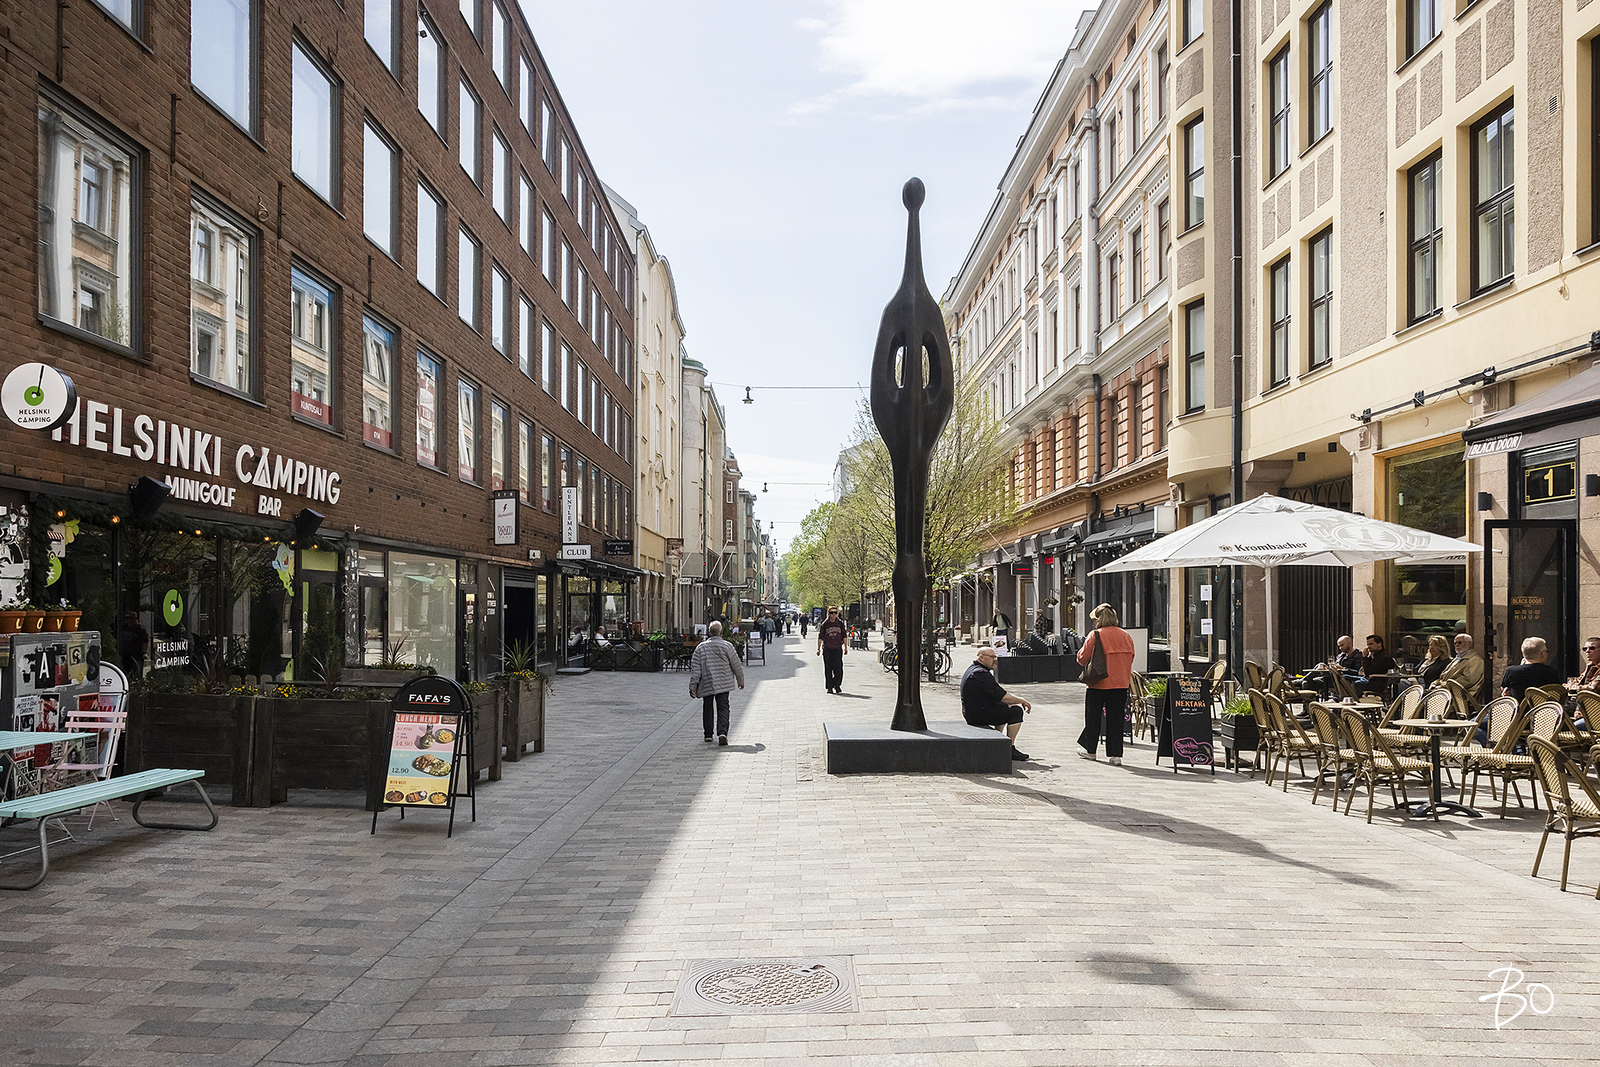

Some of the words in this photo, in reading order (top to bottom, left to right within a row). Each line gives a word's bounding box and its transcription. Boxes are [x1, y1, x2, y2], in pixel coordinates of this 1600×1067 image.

[52, 396, 222, 477] HELSINKI
[235, 443, 341, 505] CAMPING
[1470, 440, 1497, 455] BLACK
[1495, 436, 1519, 451] DOOR
[1543, 468, 1554, 497] 1
[165, 474, 236, 508] MINIGOLF
[257, 495, 282, 517] BAR
[1234, 541, 1308, 552] Krombacher
[156, 641, 189, 652] HELSINKI
[156, 655, 190, 668] CAMPING
[408, 693, 451, 703] FAFA'S
[397, 714, 418, 723] LUNCH
[419, 715, 437, 723] MENU
